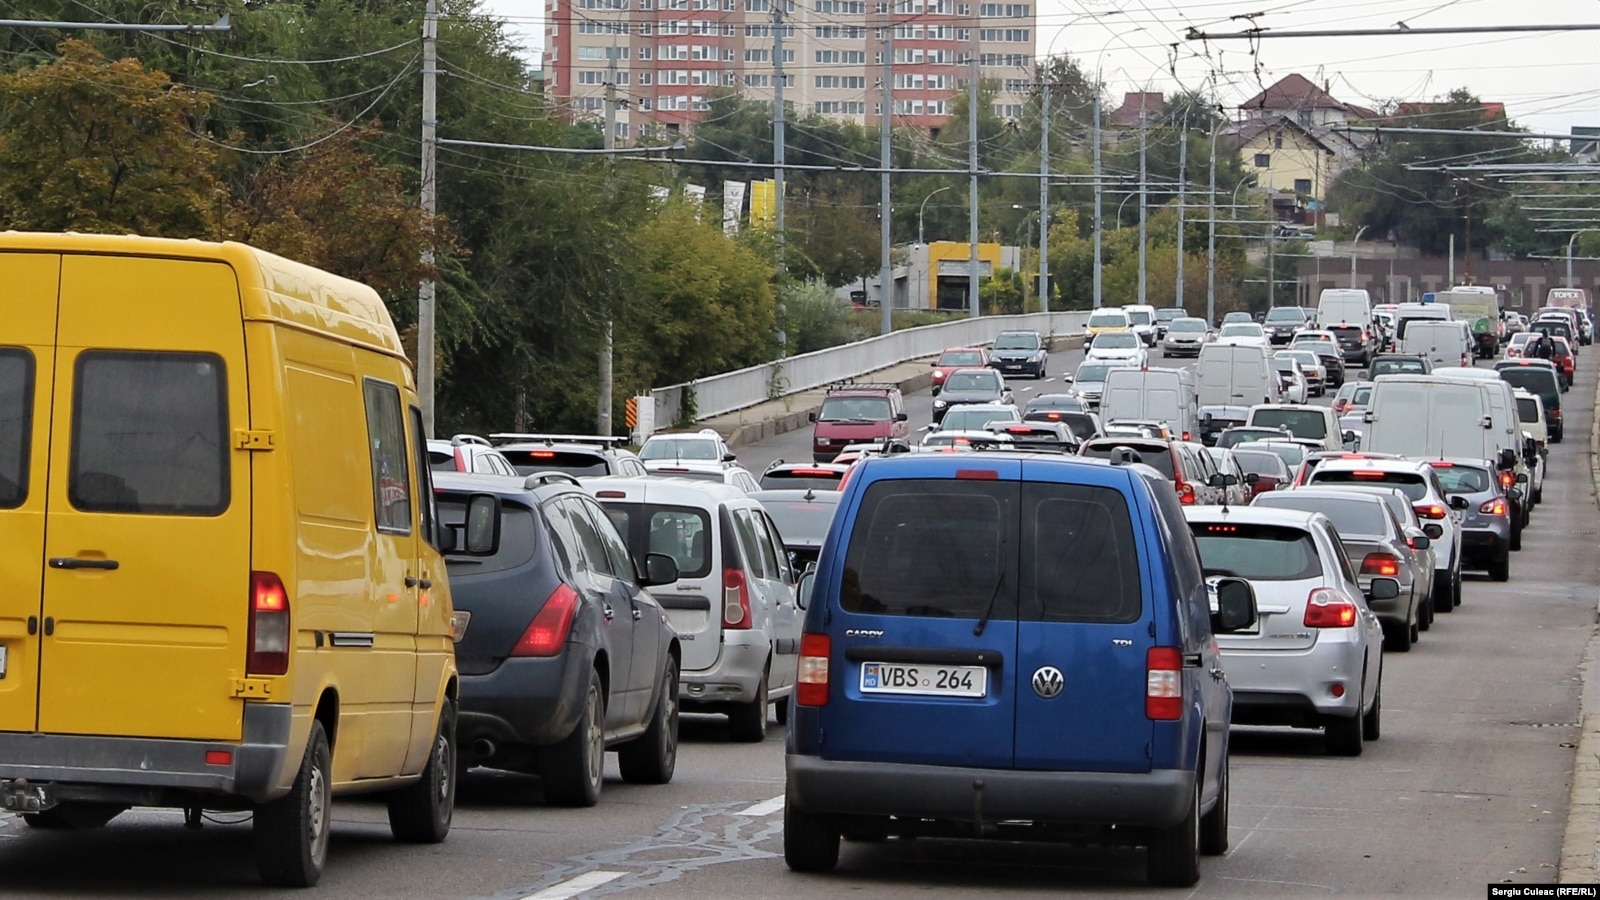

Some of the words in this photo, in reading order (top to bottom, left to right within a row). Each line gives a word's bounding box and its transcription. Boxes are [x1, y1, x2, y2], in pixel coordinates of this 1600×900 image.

[1553, 291, 1579, 299] TOPEX
[845, 629, 884, 638] CADDY
[1112, 638, 1133, 647] TDI
[864, 677, 876, 687] MD
[880, 666, 919, 688] VBS
[935, 669, 973, 690] 264
